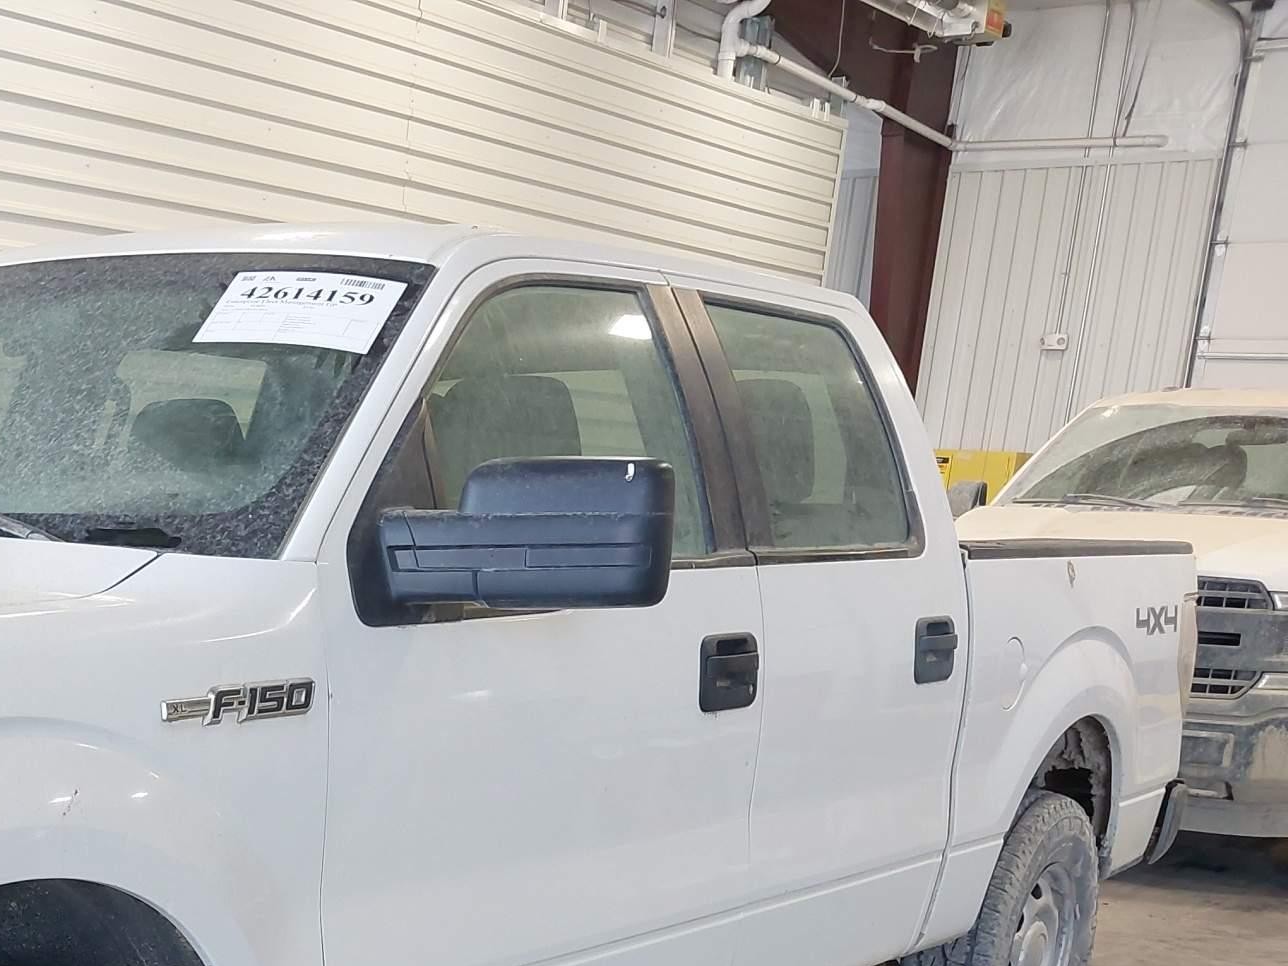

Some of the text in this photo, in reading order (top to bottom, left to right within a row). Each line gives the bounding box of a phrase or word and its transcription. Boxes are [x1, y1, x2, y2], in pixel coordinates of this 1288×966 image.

[240, 286, 376, 306] 42614159
[172, 704, 187, 713] XL
[203, 678, 315, 727] F-150
